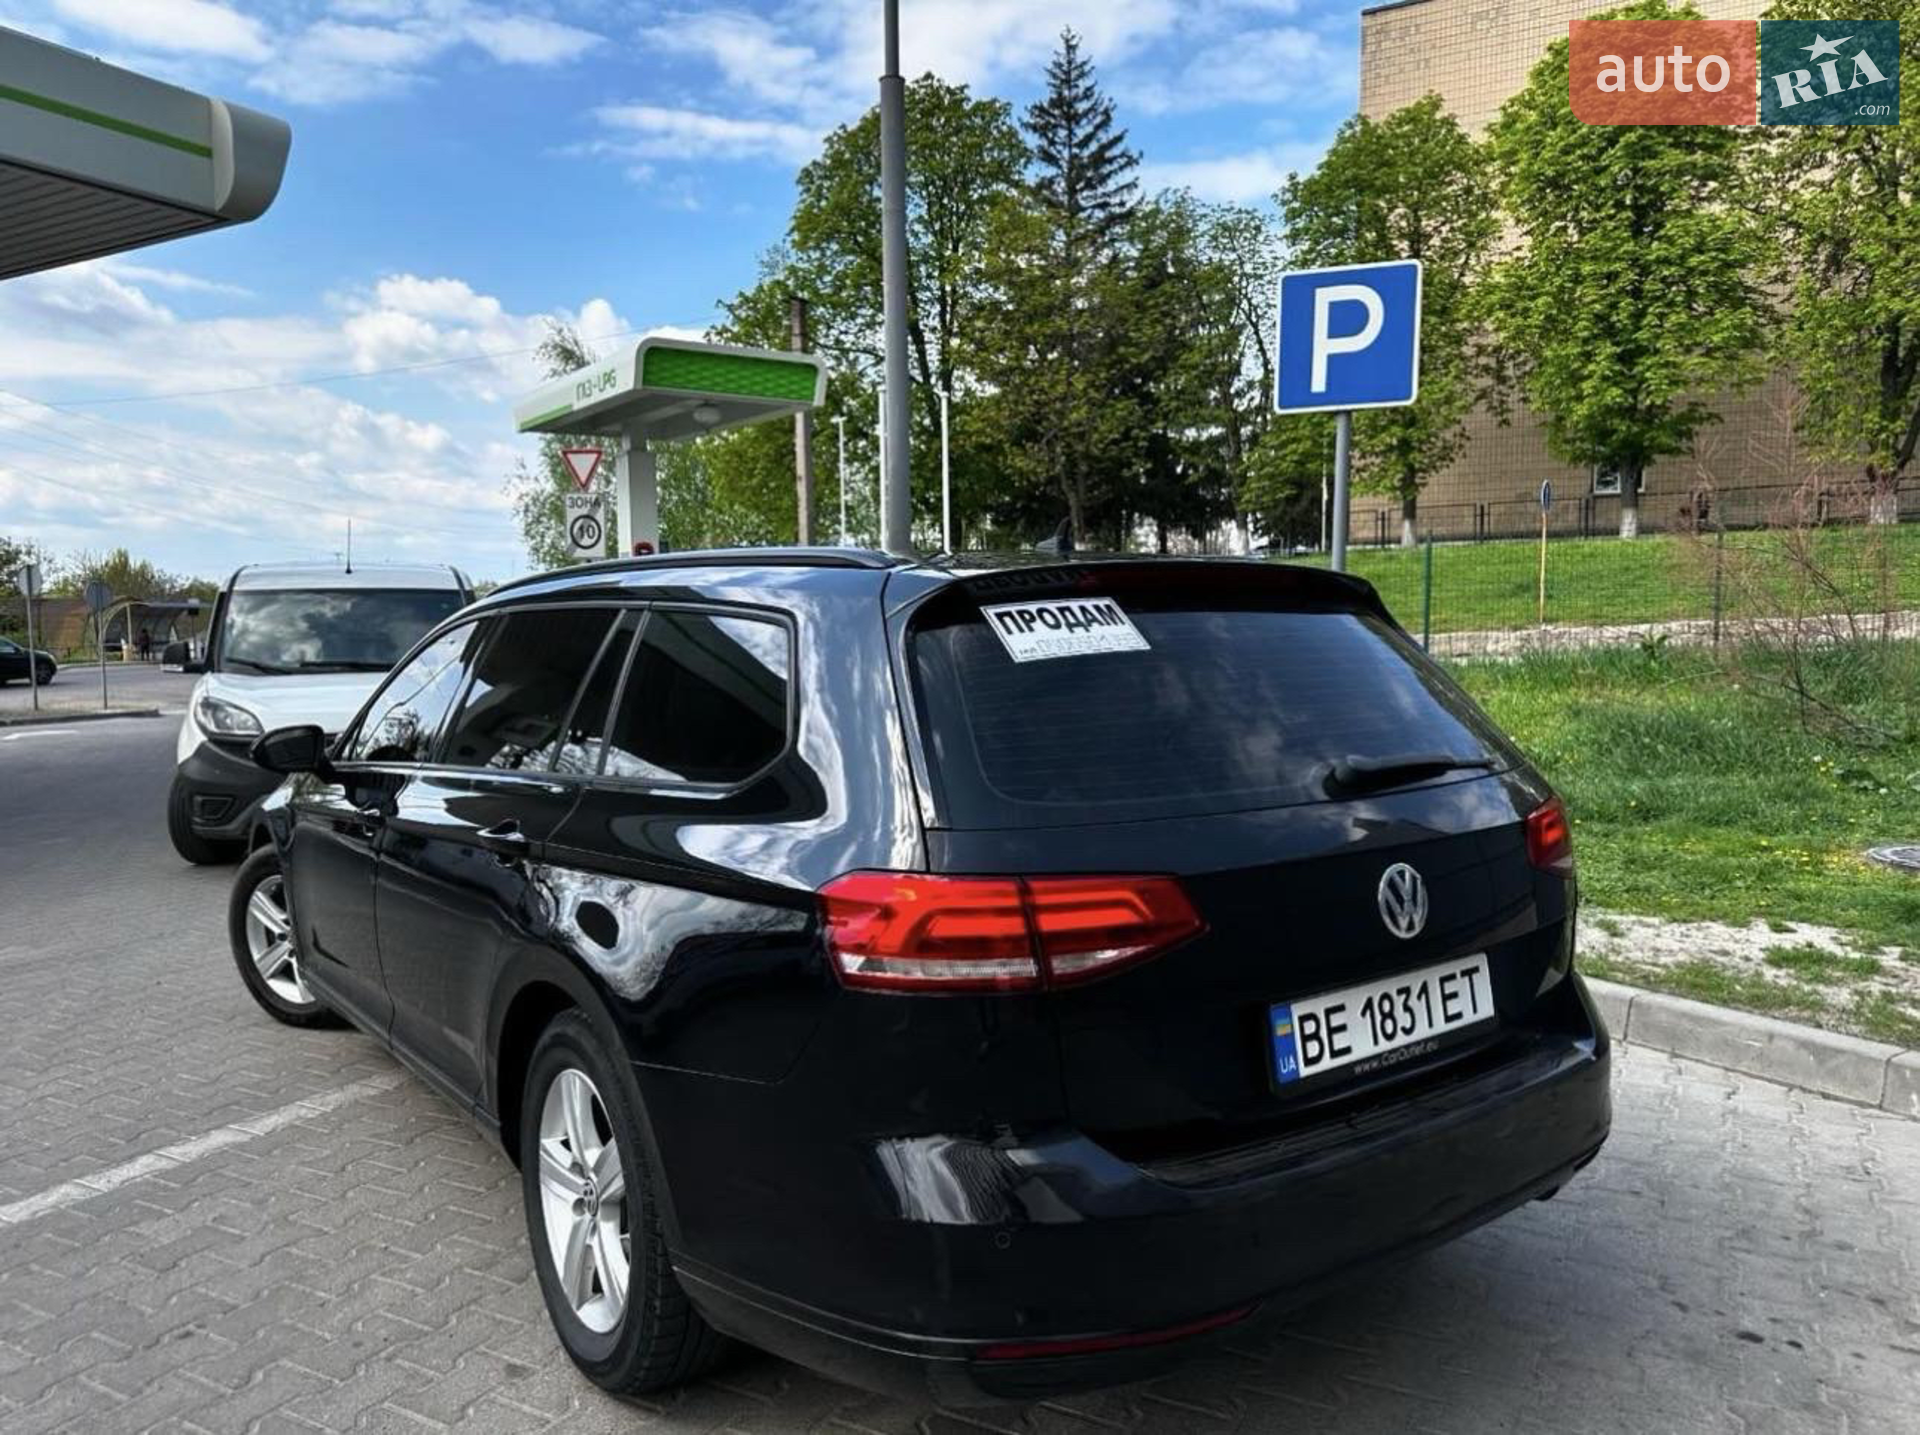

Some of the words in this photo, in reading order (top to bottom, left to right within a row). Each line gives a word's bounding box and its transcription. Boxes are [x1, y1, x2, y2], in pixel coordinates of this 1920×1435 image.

[1310, 284, 1385, 394] P
[568, 496, 602, 509] ЗОНА
[578, 523, 596, 540] 10
[994, 603, 1126, 635] ПРОДАМ
[1297, 1003, 1353, 1069] BE
[1360, 979, 1434, 1047] 1831
[1438, 965, 1481, 1024] ET
[1279, 1055, 1297, 1074] UA
